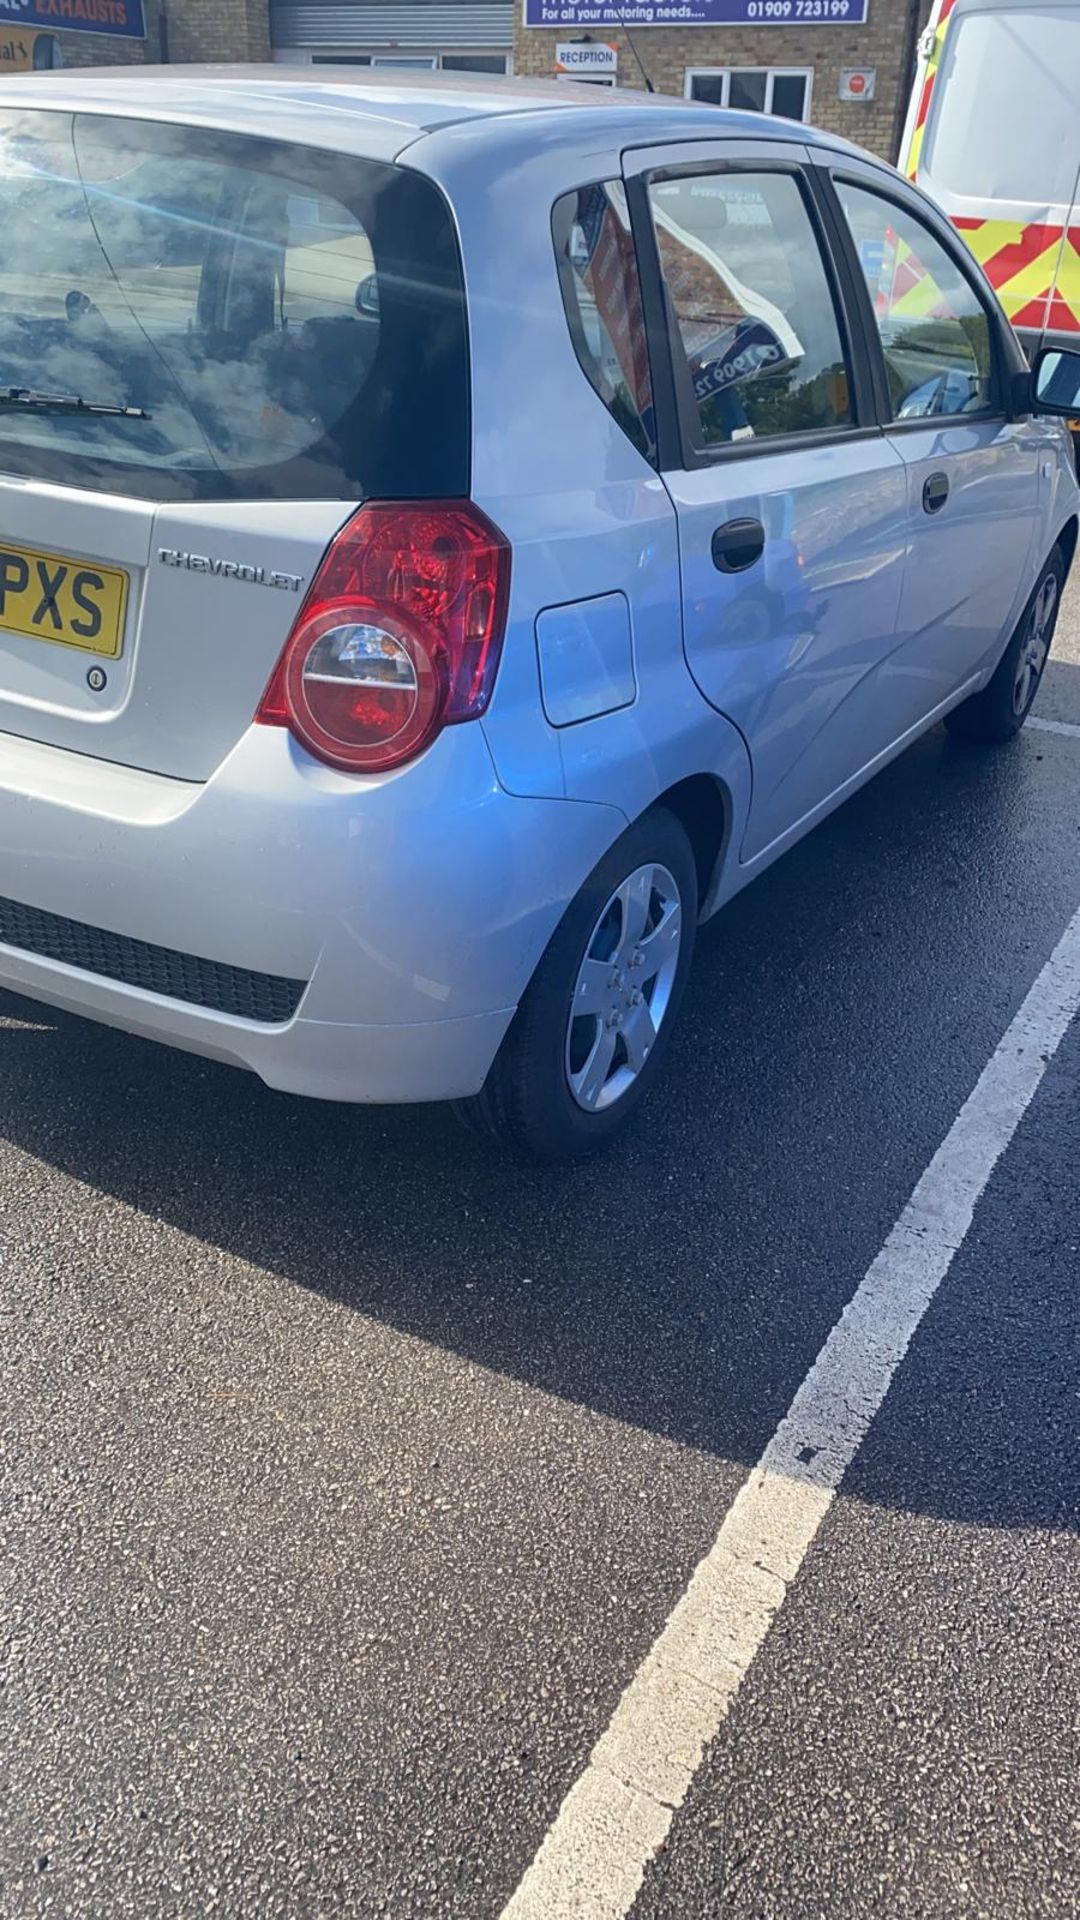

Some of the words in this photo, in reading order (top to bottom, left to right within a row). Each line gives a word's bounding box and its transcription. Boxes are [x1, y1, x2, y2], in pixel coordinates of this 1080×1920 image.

[34, 0, 128, 25] EXHAUSTS
[542, 7, 558, 20] For
[561, 7, 575, 19] all
[577, 9, 601, 21] your
[603, 6, 653, 21] motoring
[747, 1, 791, 17] 01909
[796, 1, 849, 16] 723199
[560, 51, 613, 63] RECEPTION
[158, 547, 304, 592] CHEVROLET
[0, 552, 104, 638] PXS
